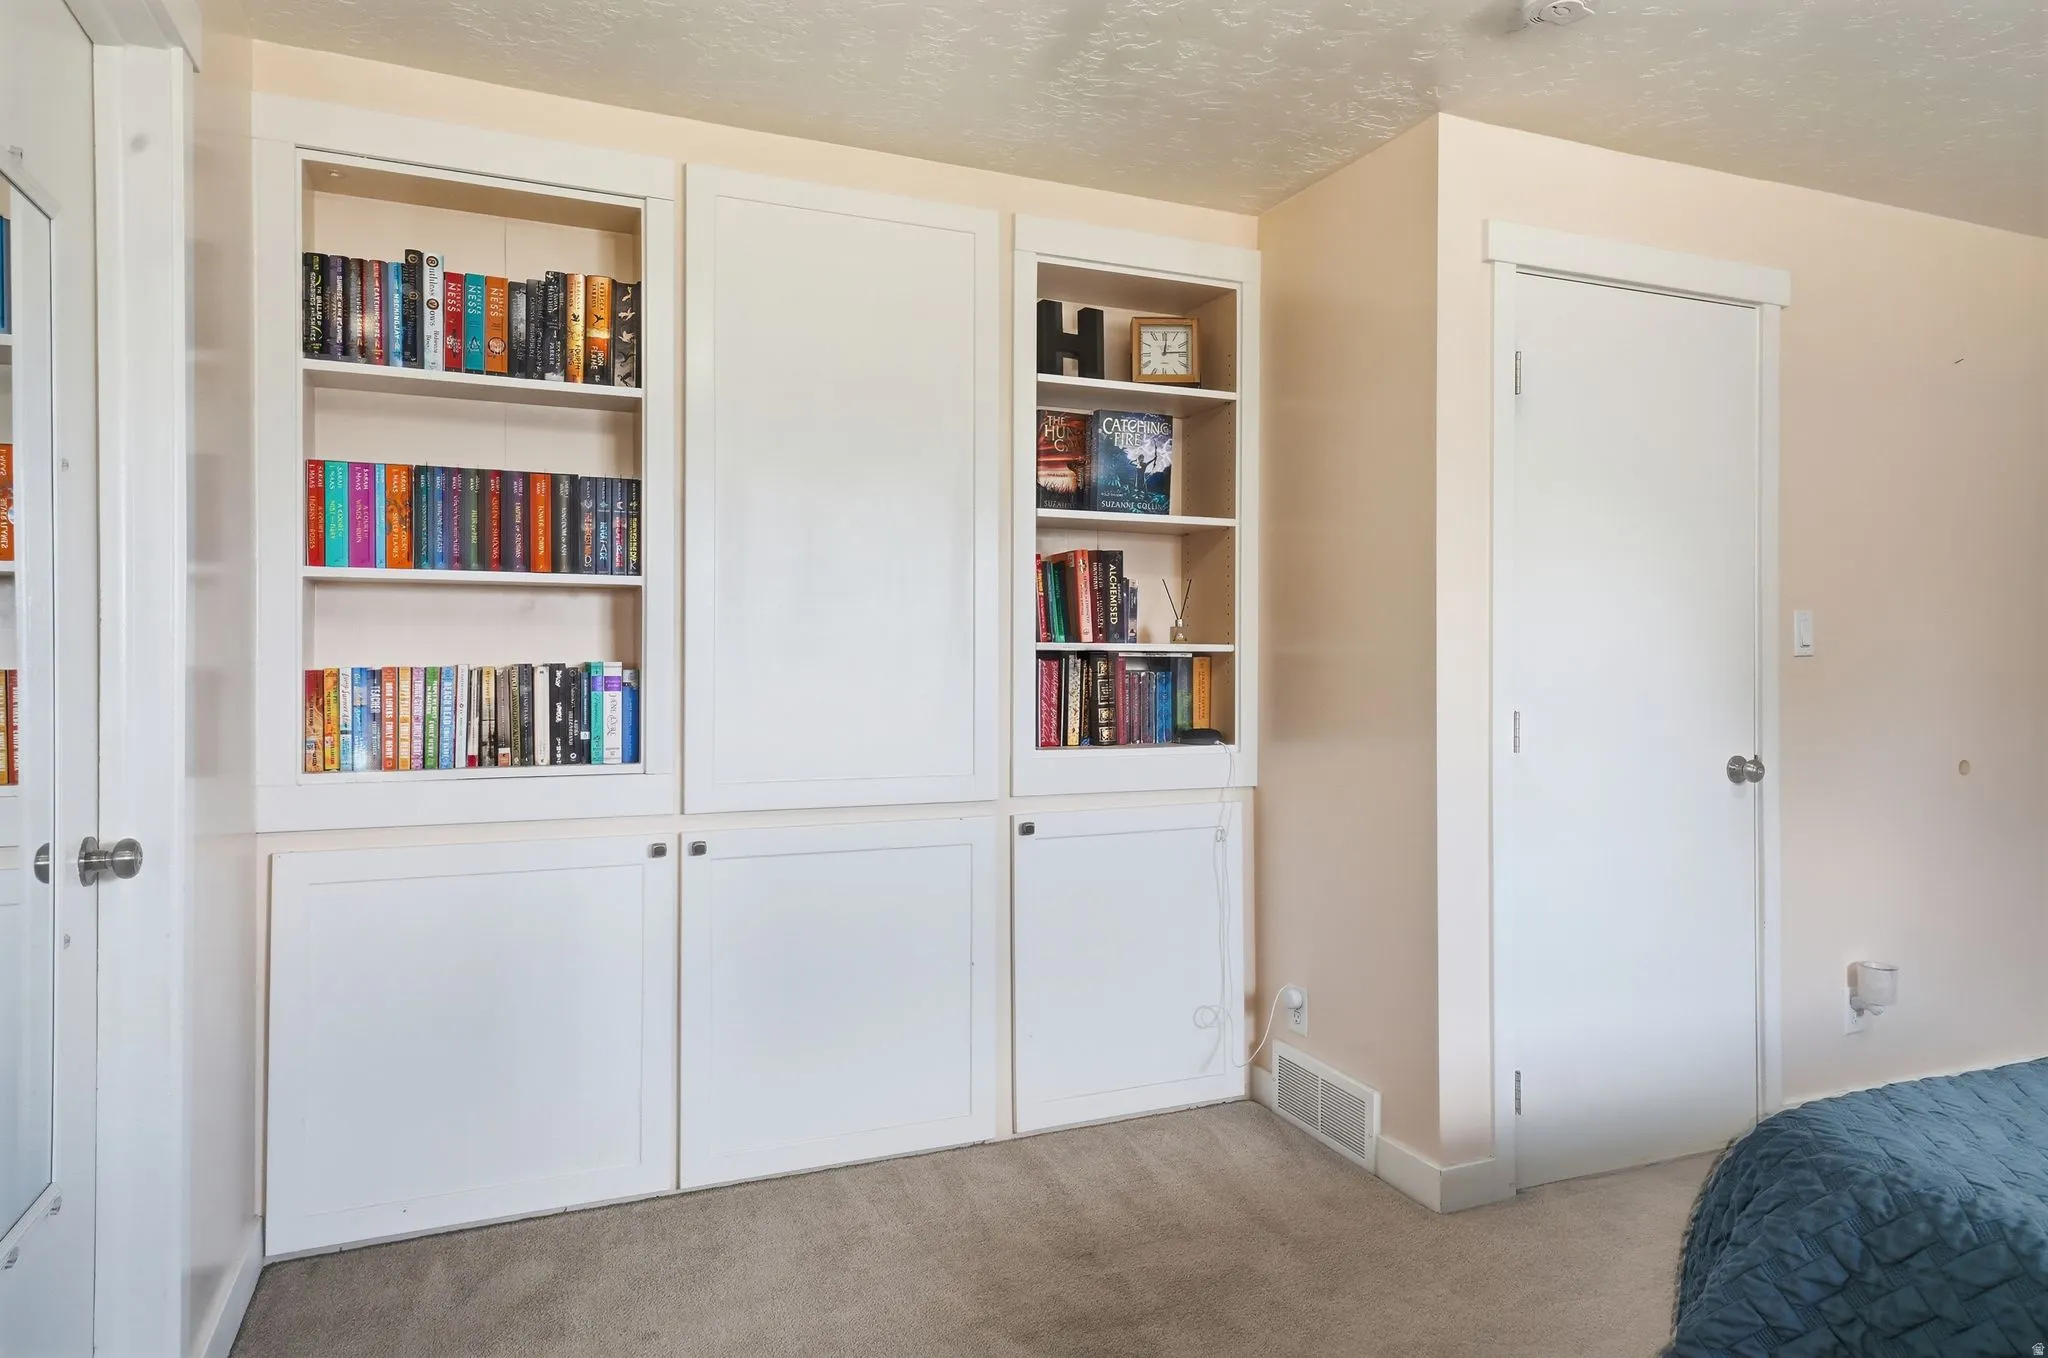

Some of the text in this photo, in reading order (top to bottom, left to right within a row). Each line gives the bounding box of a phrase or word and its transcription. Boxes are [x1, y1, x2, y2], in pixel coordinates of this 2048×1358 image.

[448, 282, 456, 312] NESS
[468, 285, 476, 314] NESS
[490, 288, 498, 316] NESS
[1047, 416, 1067, 426] THE
[1102, 417, 1171, 436] CATCHING
[1114, 432, 1141, 447] FIRE
[1101, 500, 1134, 509] SUZANNE
[600, 540, 608, 560] FADE
[1110, 564, 1118, 625] ALCHEMISED
[370, 686, 380, 714] TEACHER
[443, 682, 452, 724] BEACH READ
